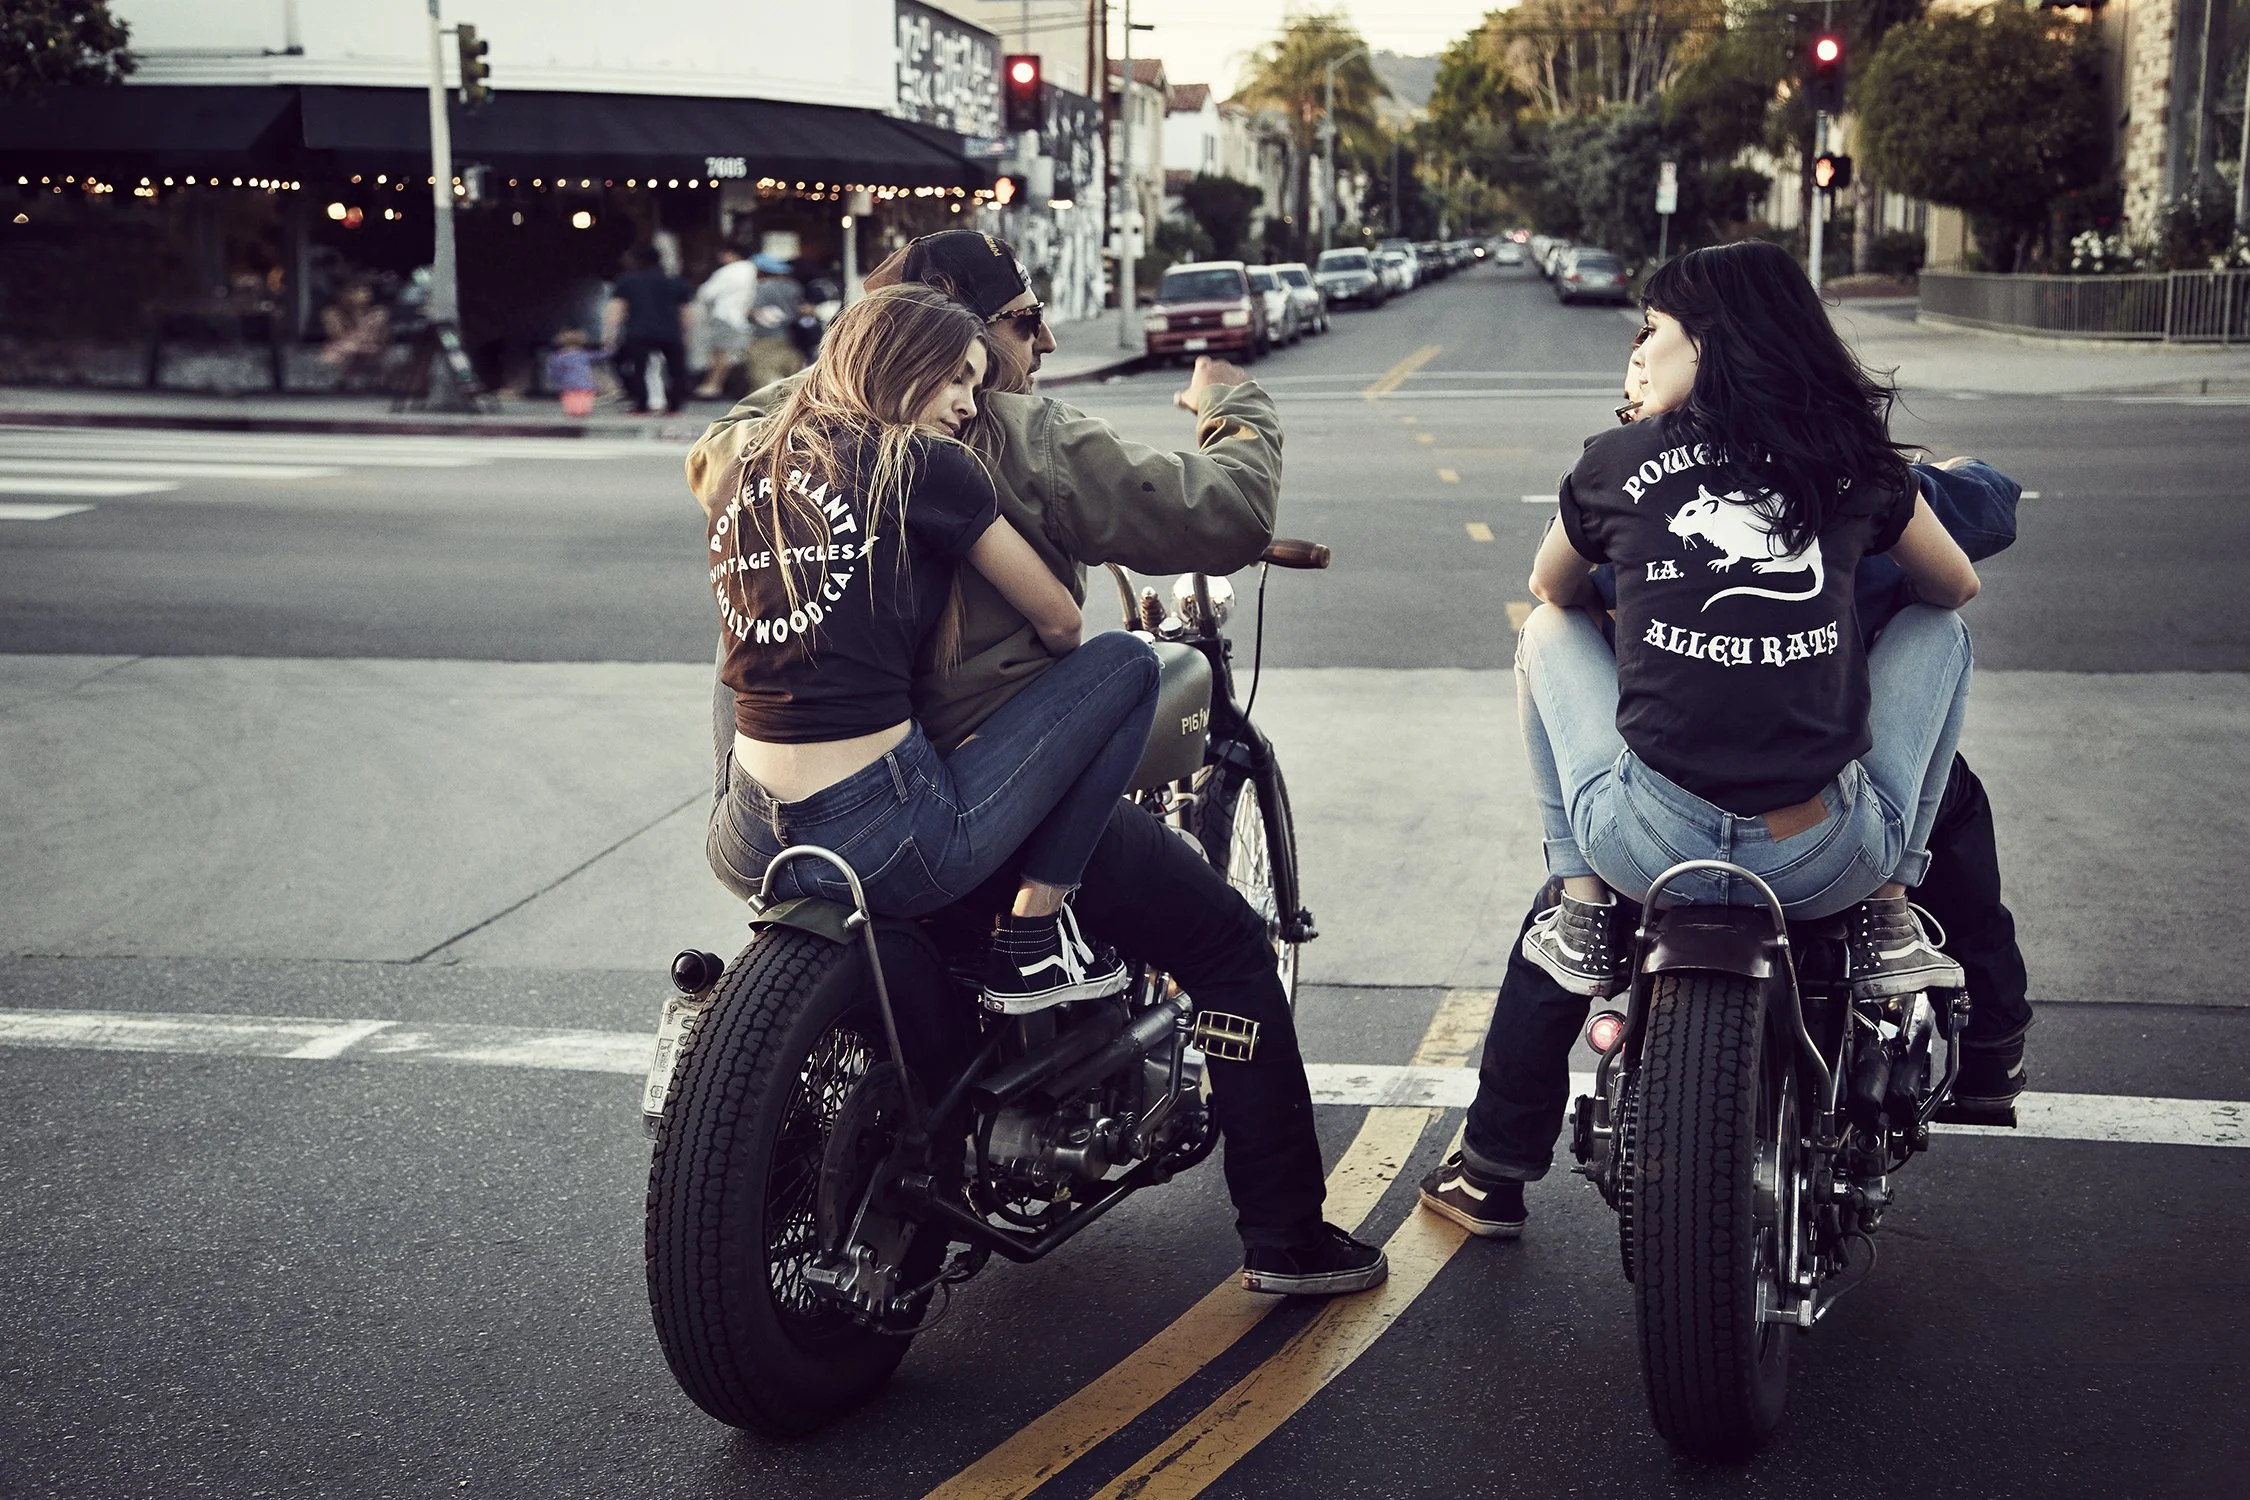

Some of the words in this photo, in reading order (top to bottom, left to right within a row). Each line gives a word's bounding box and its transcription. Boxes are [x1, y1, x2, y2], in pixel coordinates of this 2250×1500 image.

[710, 477, 773, 553] POWER
[786, 469, 858, 536] PLANT
[710, 551, 770, 584] VINTAGE
[782, 543, 855, 564] CYCLES
[1645, 559, 1685, 582] LA.
[1643, 618, 1753, 668] ALLEY
[1761, 620, 1839, 668] RATS
